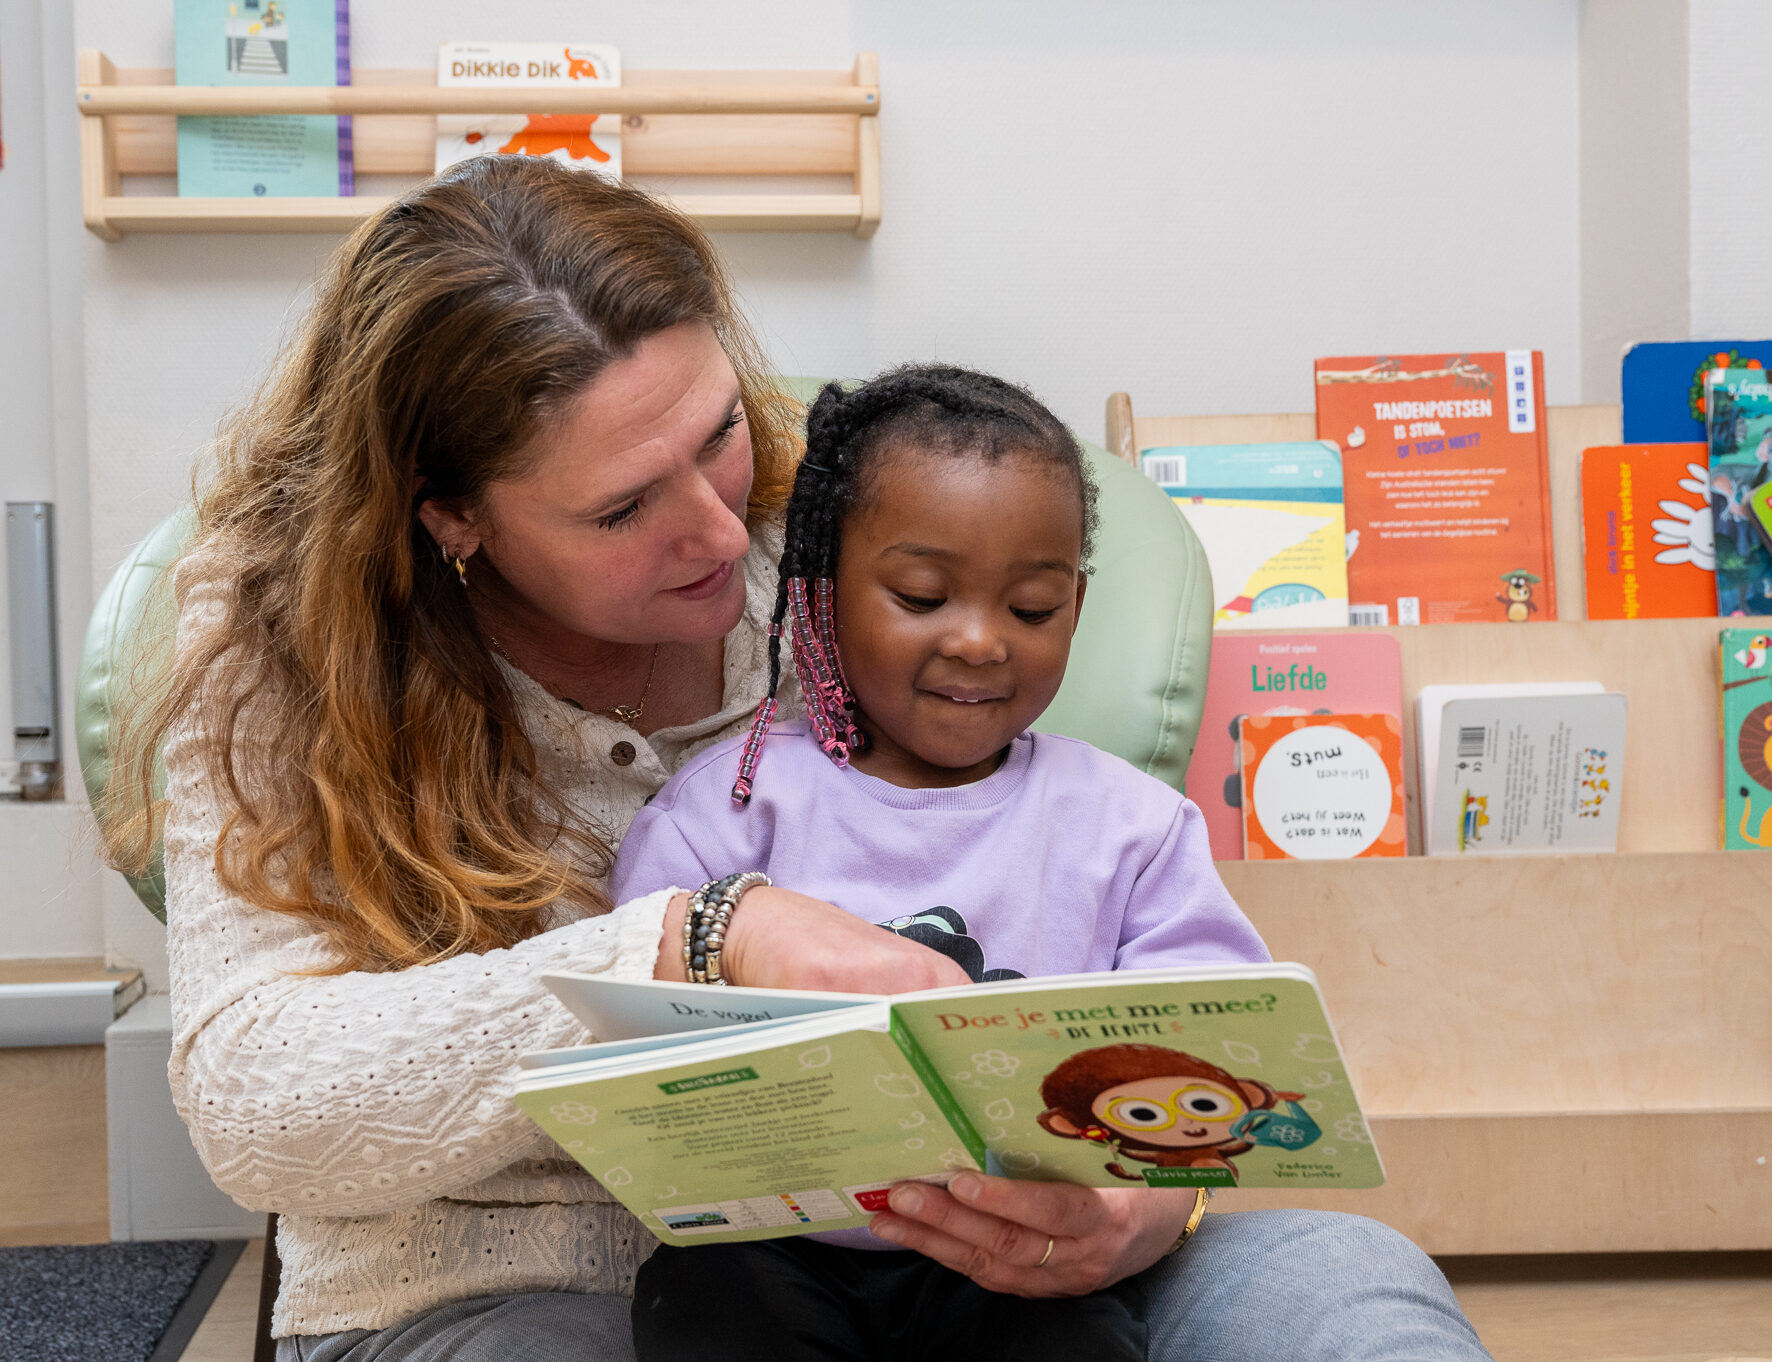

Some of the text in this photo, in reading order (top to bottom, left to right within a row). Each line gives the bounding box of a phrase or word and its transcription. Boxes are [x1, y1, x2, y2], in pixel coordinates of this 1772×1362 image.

[1373, 399, 1493, 420] TANDENPOETSEN
[1394, 421, 1445, 439] IS STOM,
[1397, 432, 1481, 459] OF TOCH NIET?
[1618, 462, 1633, 521] verkeer
[1621, 525, 1634, 550] het
[1621, 554, 1635, 569] in
[1252, 664, 1327, 691] Liefde
[1285, 827, 1315, 838] dat?
[1337, 827, 1362, 837] Wat
[669, 1002, 773, 1023] De vogel
[936, 993, 1278, 1032] Doe je met me mee?
